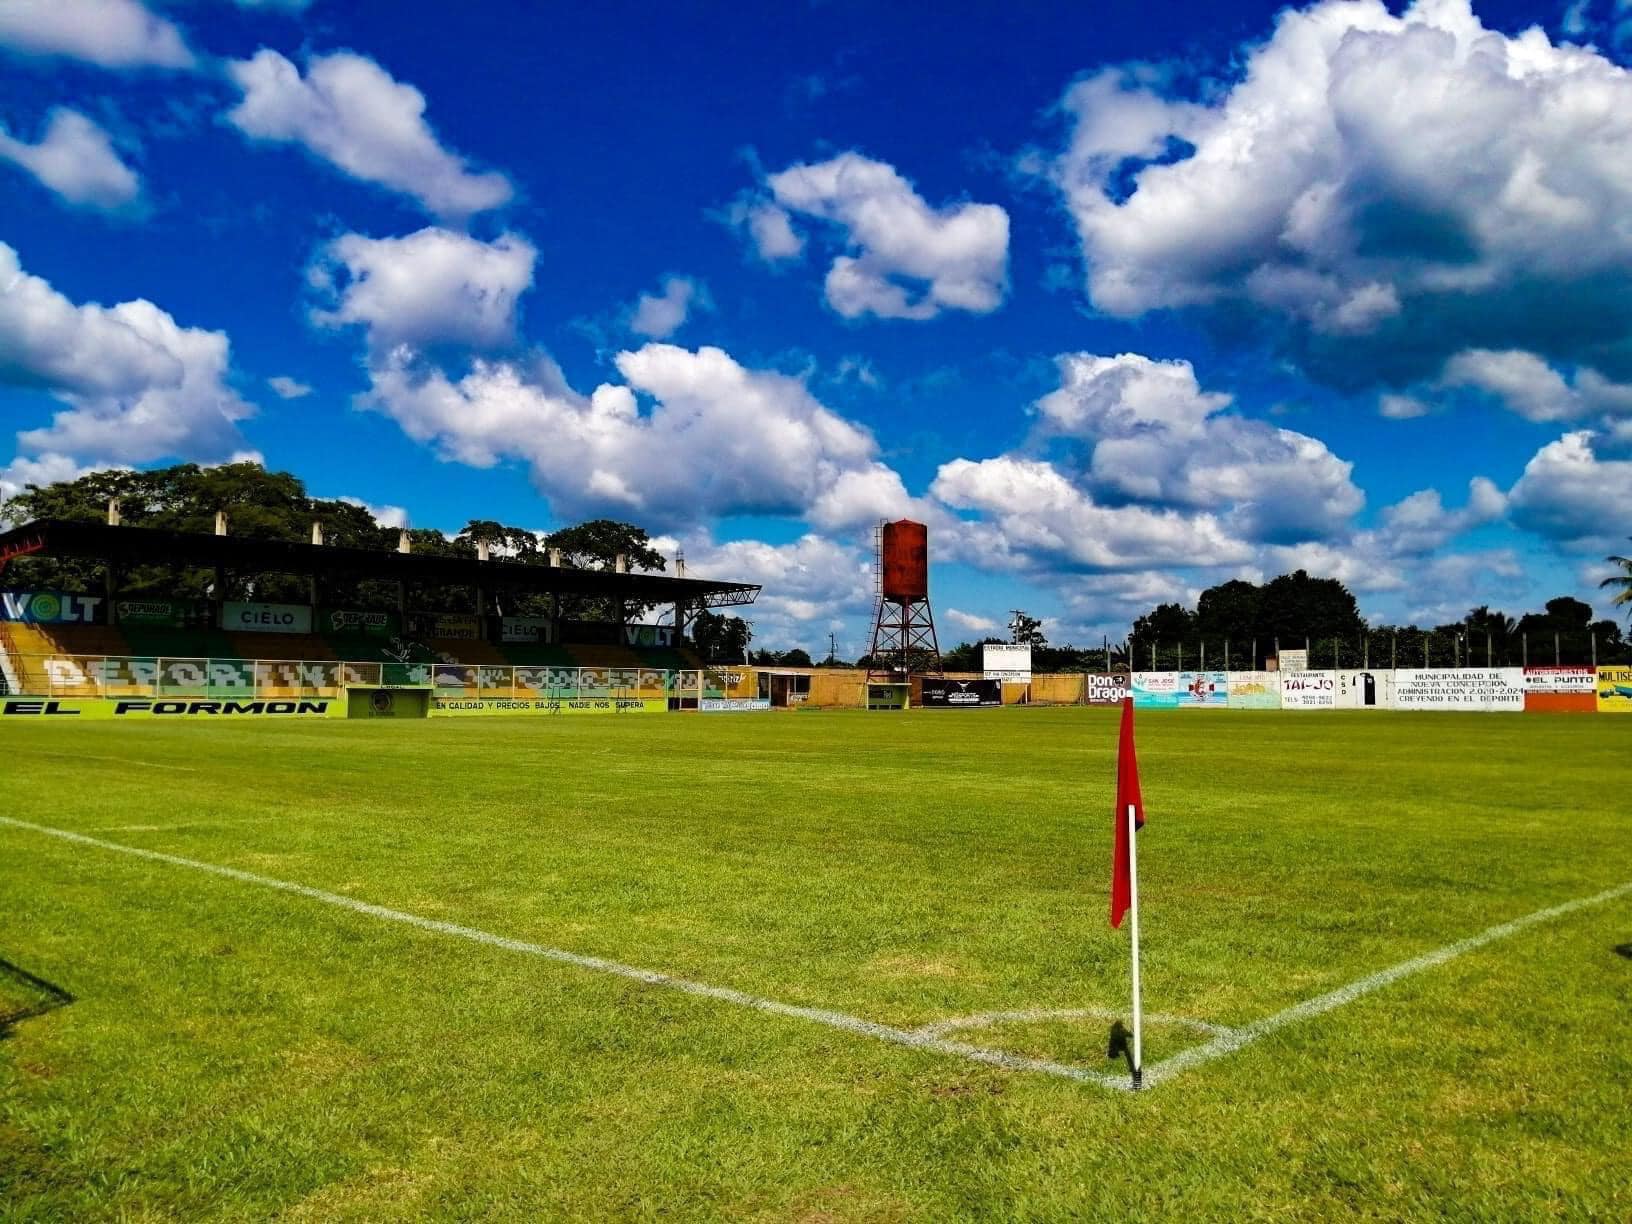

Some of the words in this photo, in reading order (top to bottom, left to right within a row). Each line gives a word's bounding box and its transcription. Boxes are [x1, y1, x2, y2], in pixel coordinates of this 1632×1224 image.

[1, 592, 103, 622] VOLT
[241, 611, 294, 624] CIELO
[1088, 674, 1113, 686] Don
[1415, 672, 1484, 681] MUNICIPALIDAD
[1489, 672, 1504, 680] DE
[1532, 676, 1548, 684] EL
[1088, 687, 1126, 703] Drago
[1399, 695, 1447, 703] CREYENDO
[3, 701, 81, 715] EL
[113, 702, 329, 714] FORMON
[436, 702, 446, 710] EN
[448, 702, 484, 710] CALIDAD
[487, 702, 494, 710] Y
[496, 701, 530, 709] PRECIOS
[568, 701, 591, 709] NADIE
[594, 701, 610, 709] NOS
[615, 701, 644, 709] SUPERA
